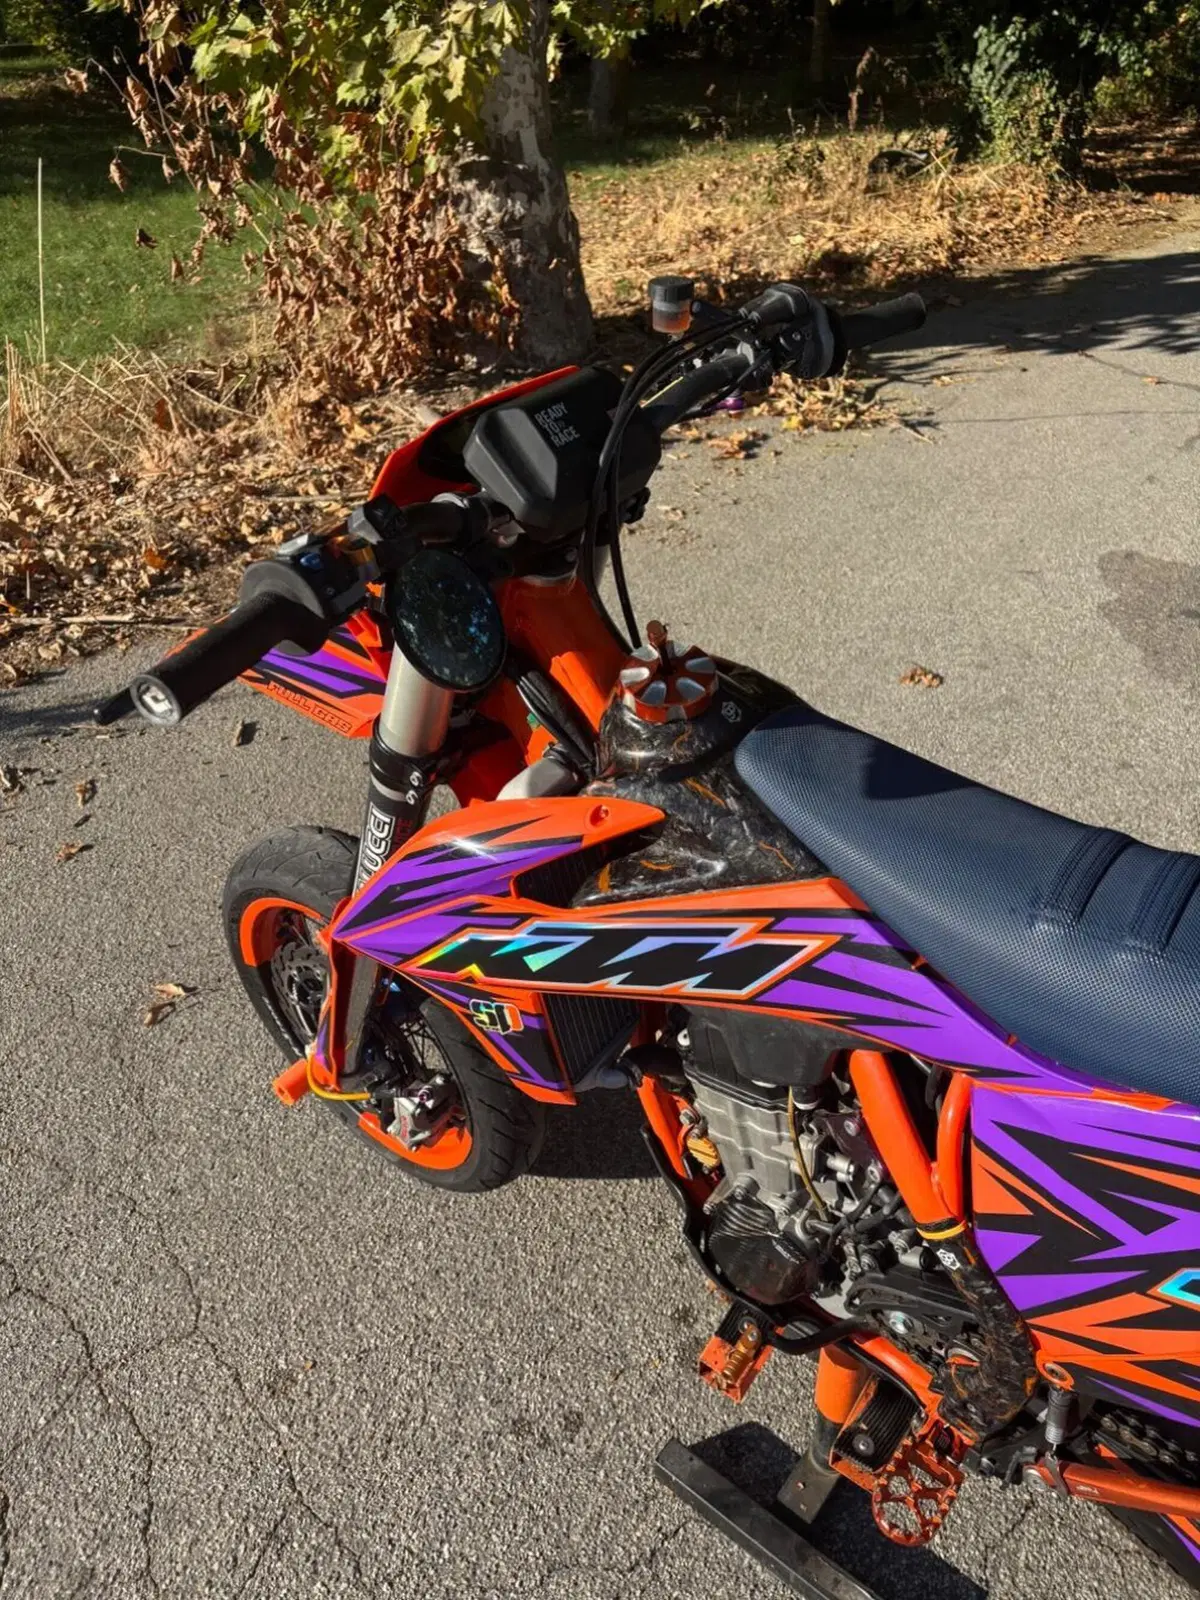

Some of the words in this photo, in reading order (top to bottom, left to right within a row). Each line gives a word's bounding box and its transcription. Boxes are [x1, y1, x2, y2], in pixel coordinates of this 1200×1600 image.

[534, 401, 568, 429] READY
[551, 426, 580, 448] RACE
[267, 681, 311, 711] FULL
[311, 703, 353, 734] GAS
[402, 920, 830, 997] KTM
